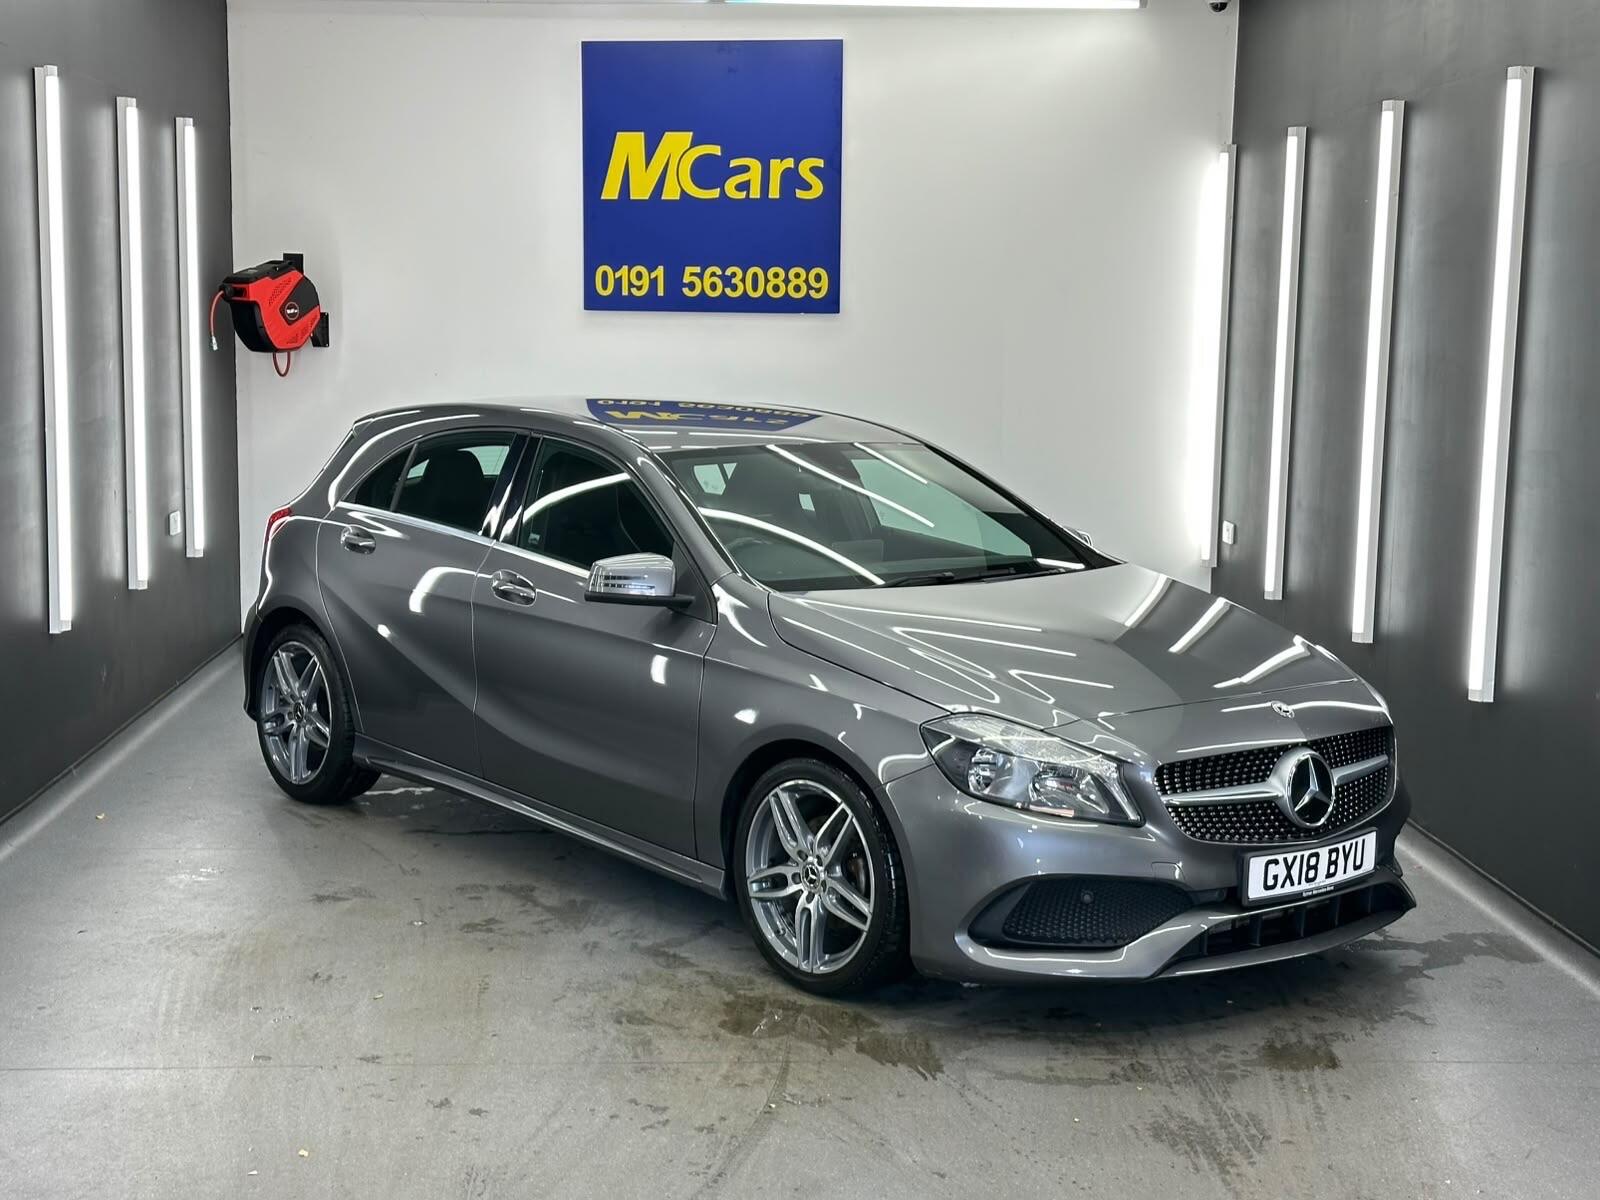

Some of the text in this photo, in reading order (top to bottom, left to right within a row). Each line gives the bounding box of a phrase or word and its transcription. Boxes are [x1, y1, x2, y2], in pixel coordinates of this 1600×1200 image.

[600, 131, 825, 200] MCars
[594, 264, 829, 299] 0191 5630889
[1262, 838, 1366, 891] GX18 BYU
